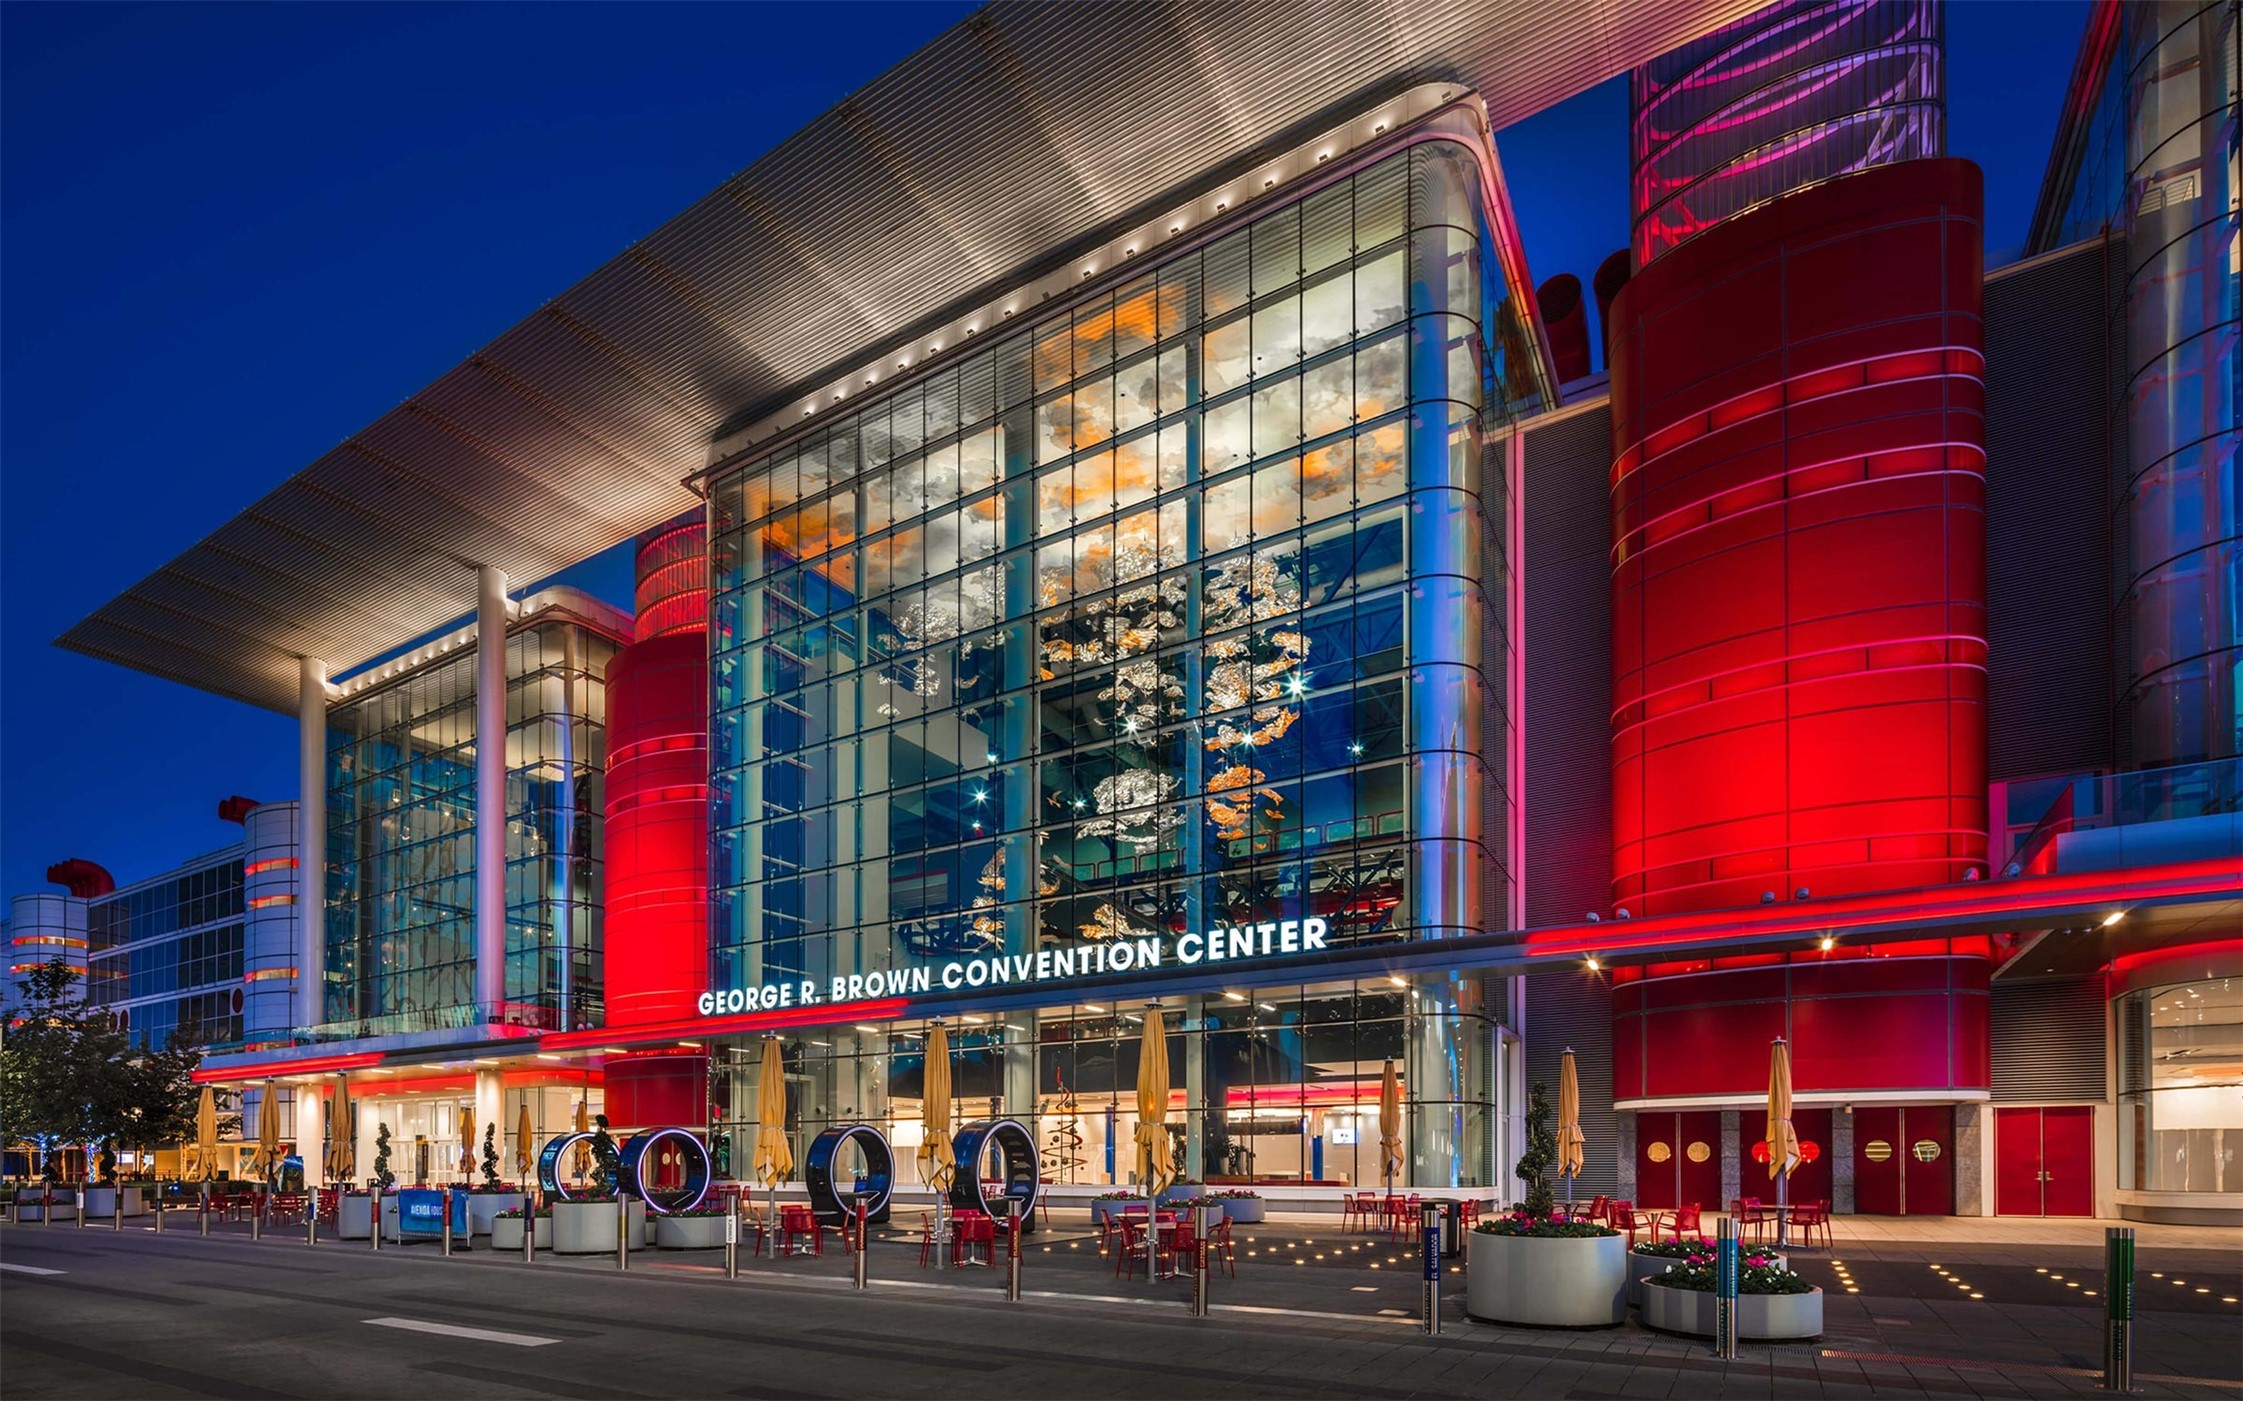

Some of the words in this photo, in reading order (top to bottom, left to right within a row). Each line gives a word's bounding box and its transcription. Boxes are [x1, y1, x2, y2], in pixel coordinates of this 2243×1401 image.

[698, 983, 791, 1015] GEORGE
[800, 981, 820, 1004] R.
[832, 966, 930, 1000] BROWN
[942, 937, 1160, 989] CONVENTION
[1177, 918, 1327, 963] CENTER
